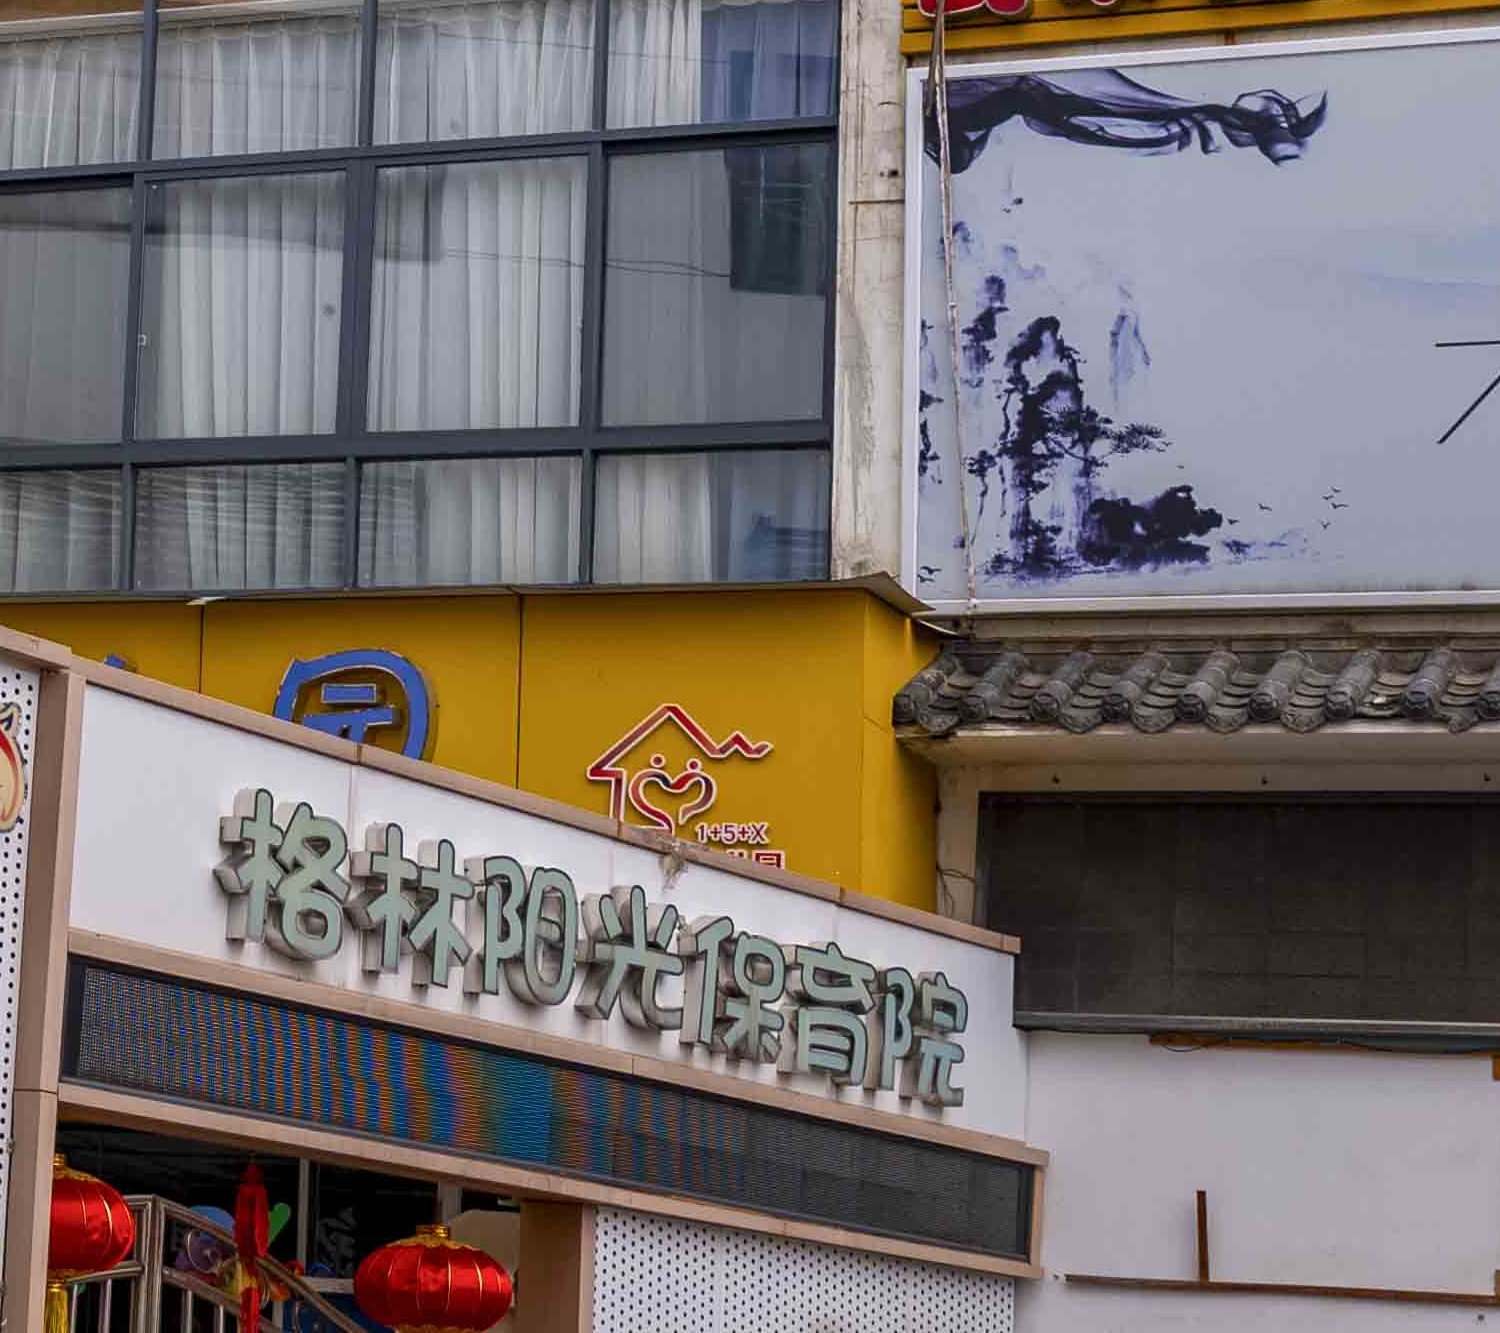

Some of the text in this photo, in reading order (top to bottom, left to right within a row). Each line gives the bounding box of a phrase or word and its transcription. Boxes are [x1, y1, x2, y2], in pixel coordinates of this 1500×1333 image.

[696, 821, 769, 844] 1+5+X
[214, 785, 969, 1108] 格林阳光保育院
